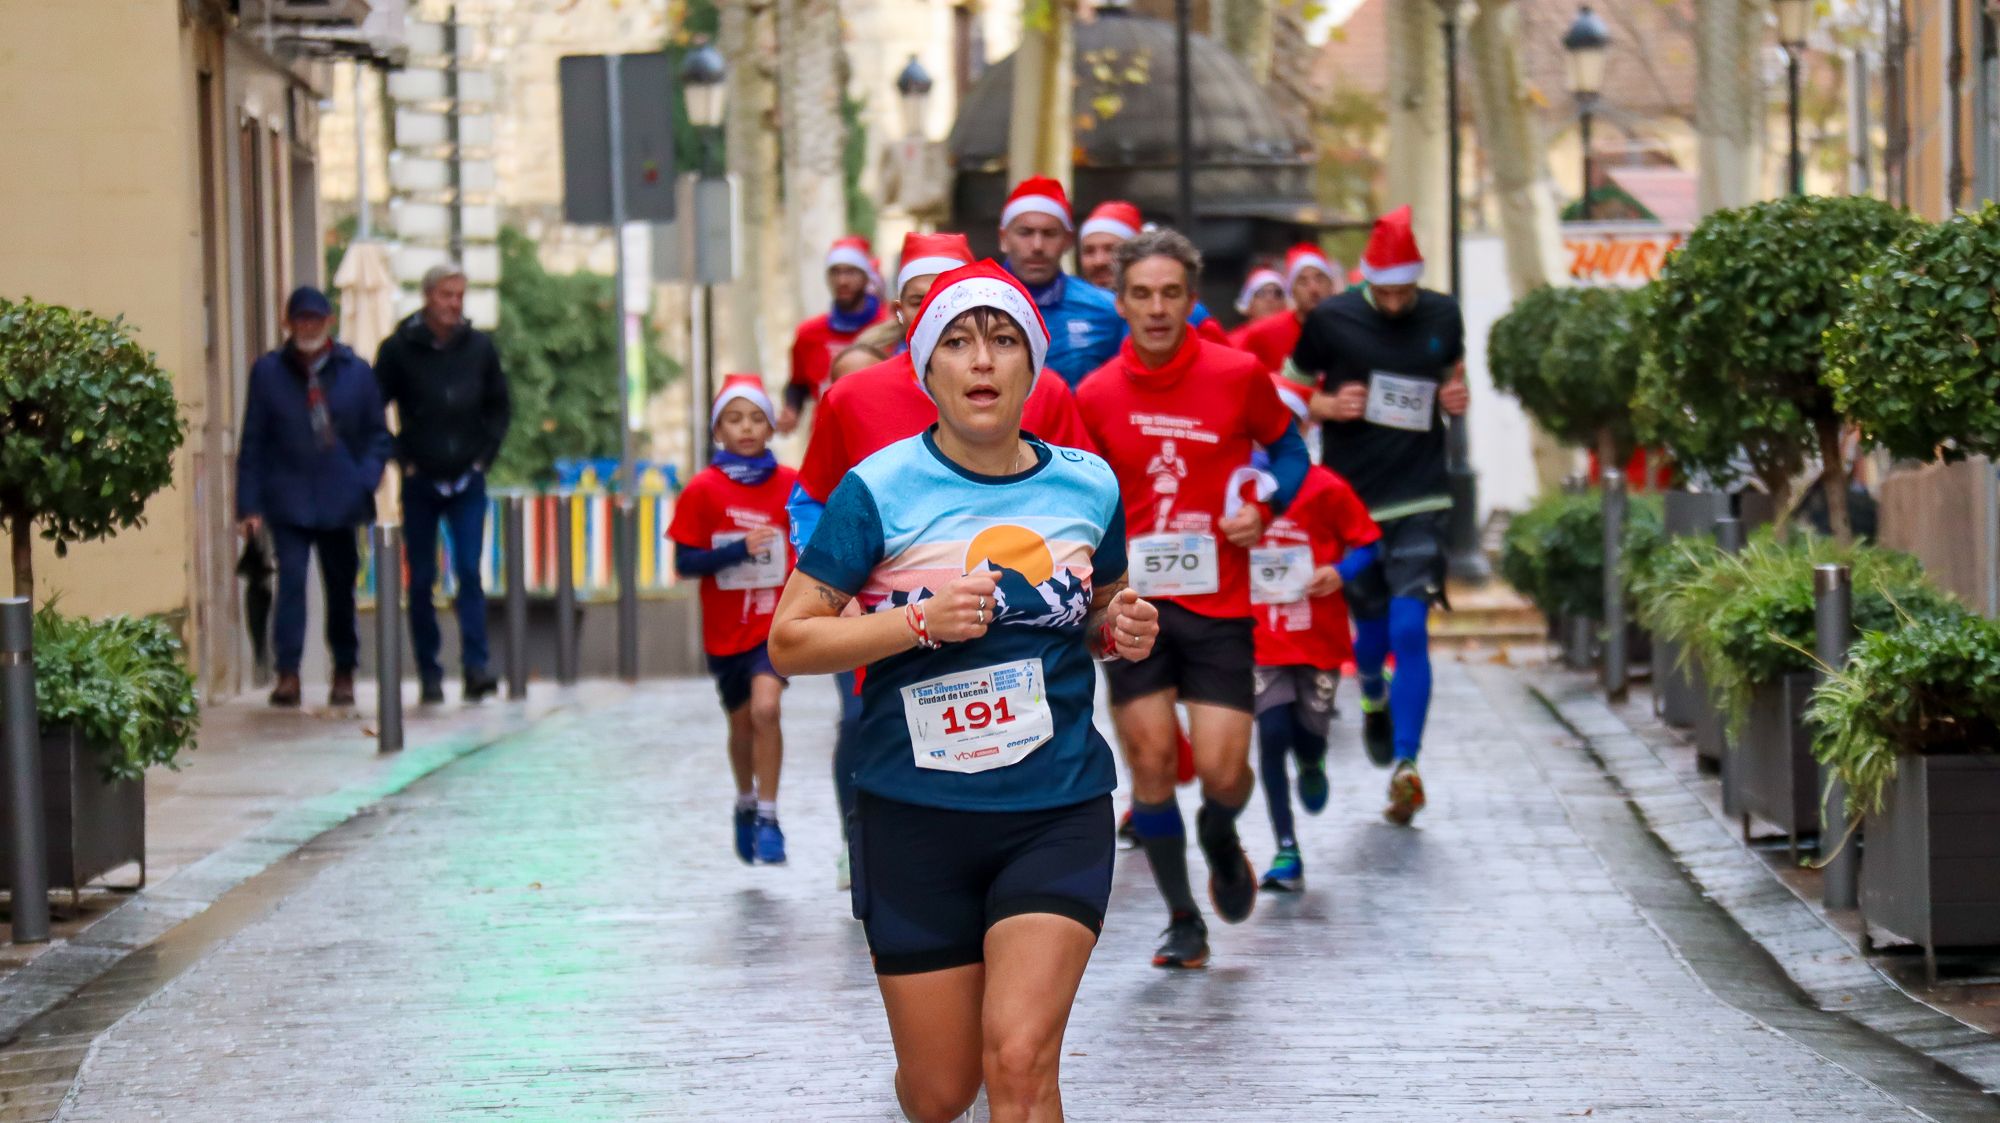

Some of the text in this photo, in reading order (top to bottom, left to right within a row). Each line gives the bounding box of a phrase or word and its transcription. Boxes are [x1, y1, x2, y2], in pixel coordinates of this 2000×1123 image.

[1145, 553, 1199, 572] 570
[1262, 566, 1288, 581] 97
[917, 688, 933, 697] San
[934, 682, 970, 694] Silvestre
[918, 688, 989, 705] Ciudad de Lucena
[942, 696, 1016, 735] 191
[1006, 735, 1041, 748] enerplus
